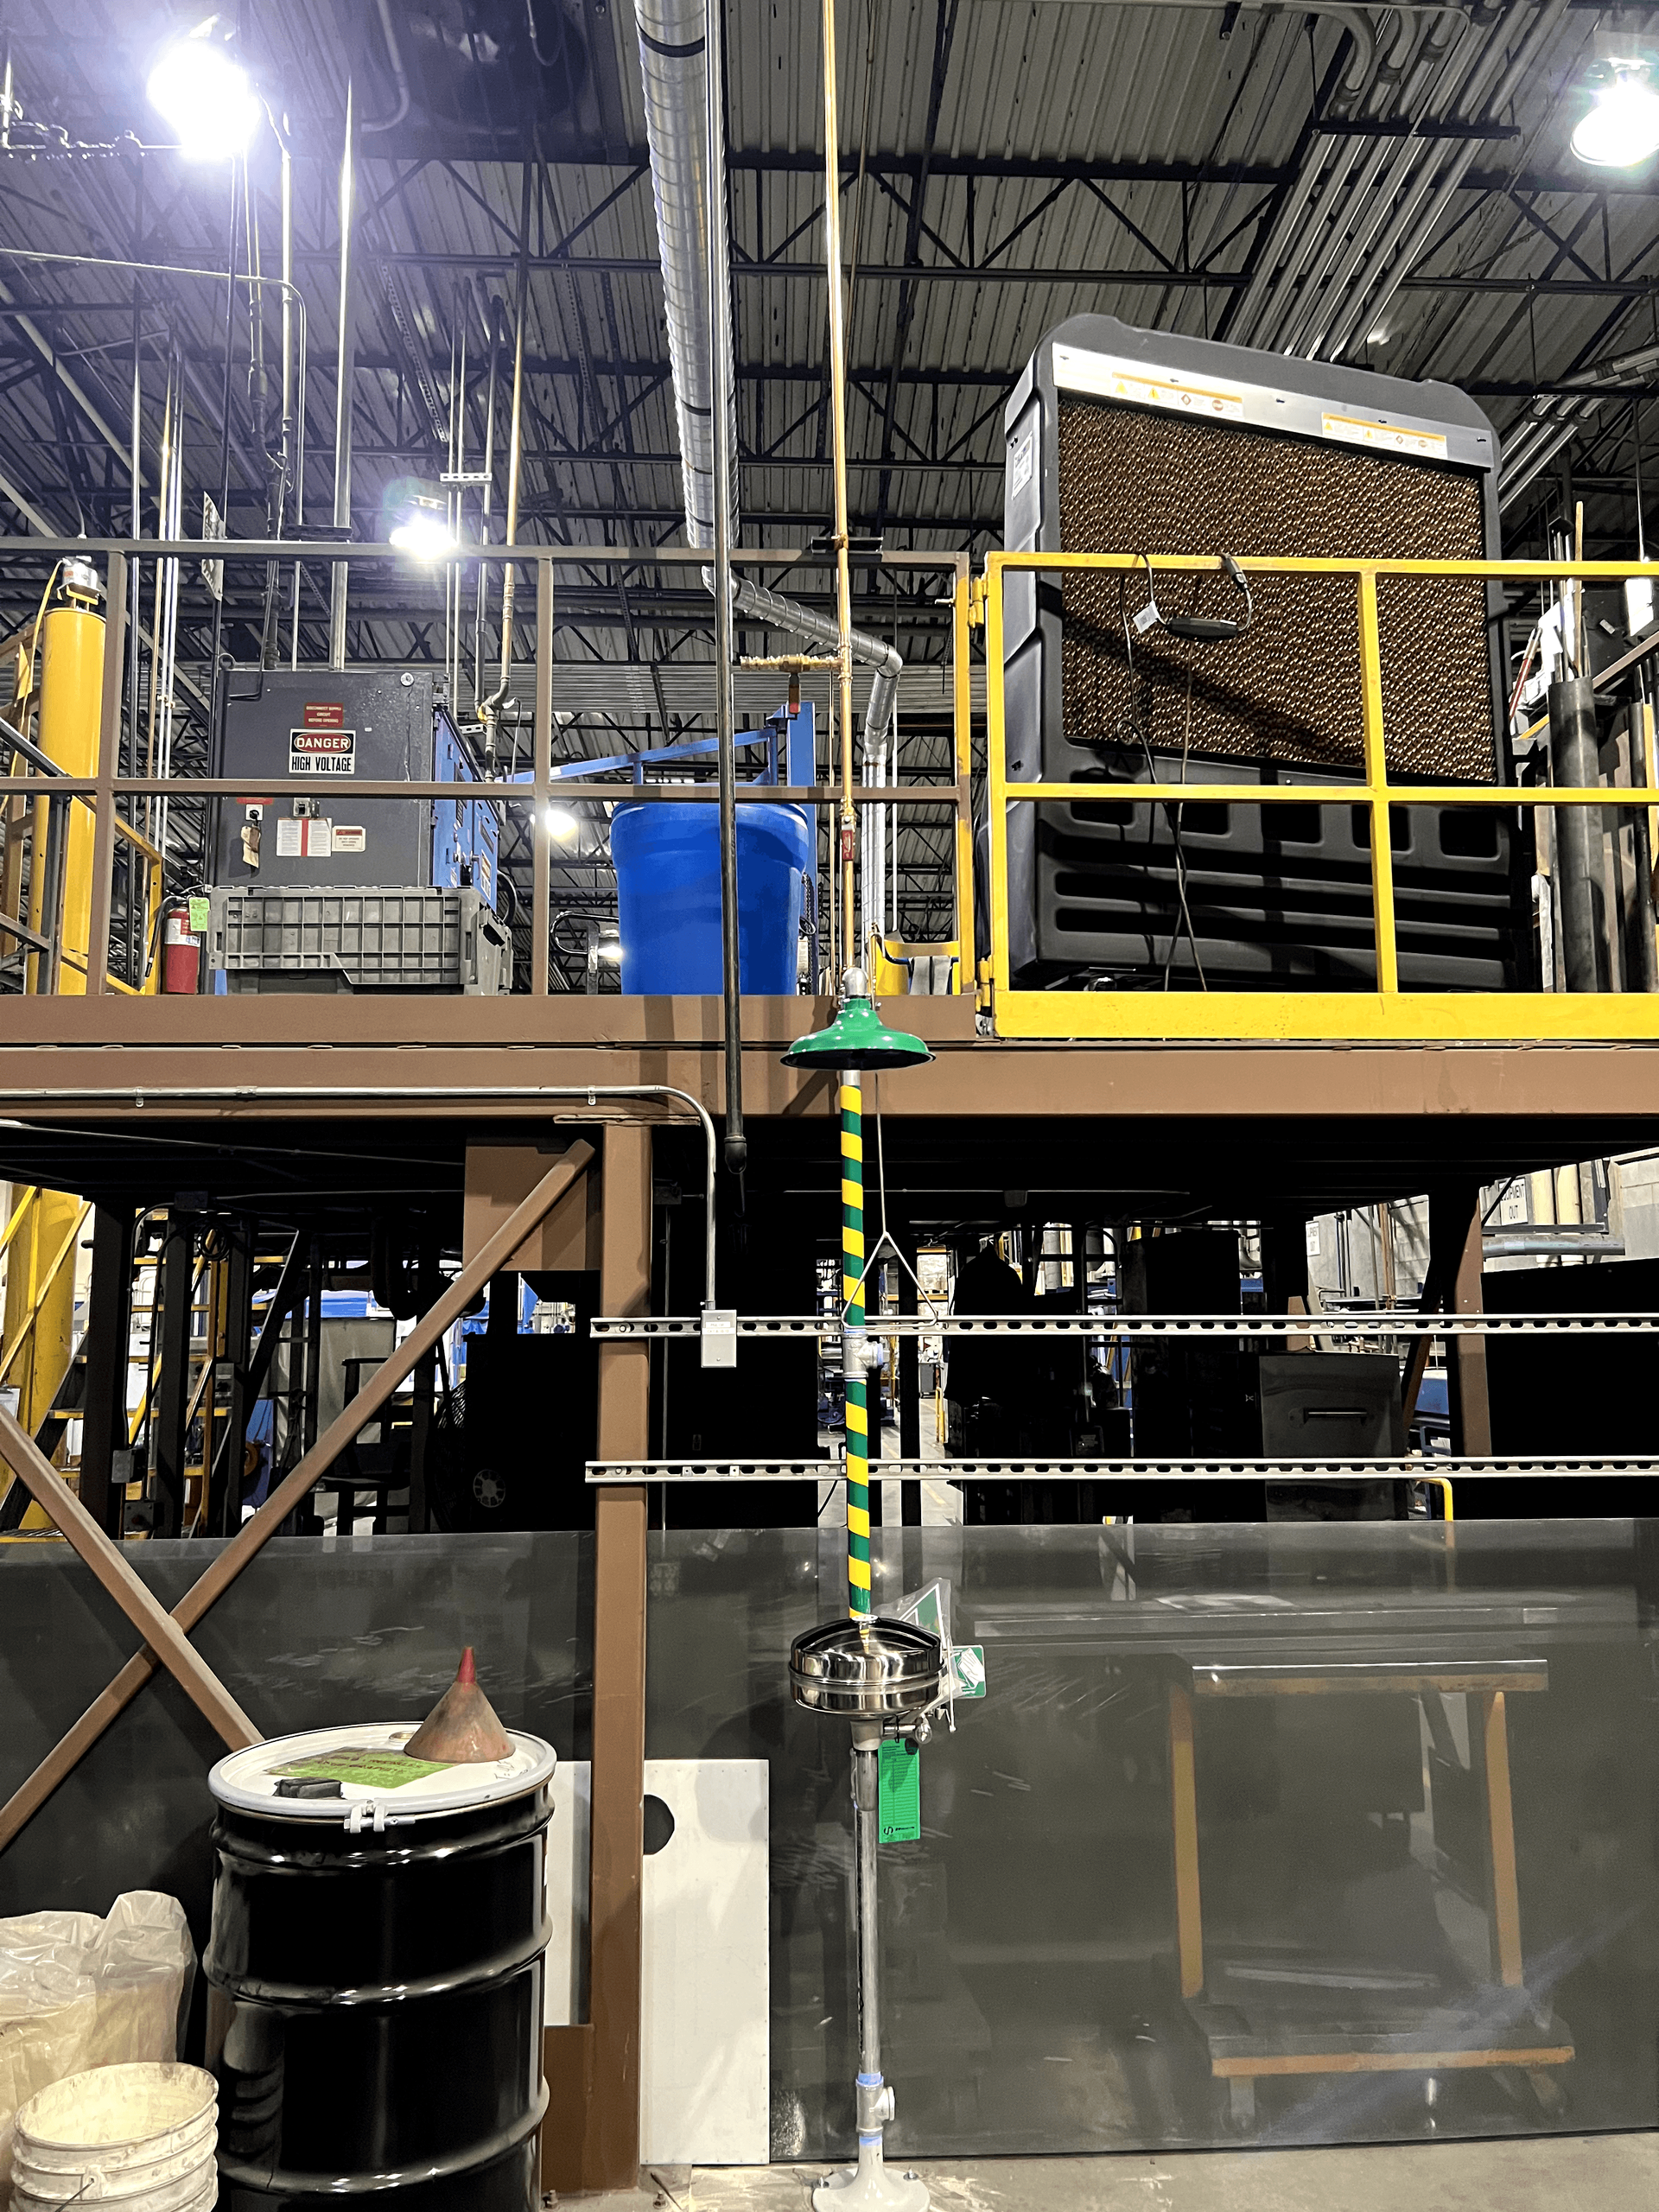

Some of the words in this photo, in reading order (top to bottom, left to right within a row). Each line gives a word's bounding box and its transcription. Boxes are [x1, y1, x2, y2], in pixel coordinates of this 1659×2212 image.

[296, 738, 349, 749] DANGER
[291, 756, 311, 771] HIGH
[315, 756, 352, 772] VOLTAGE
